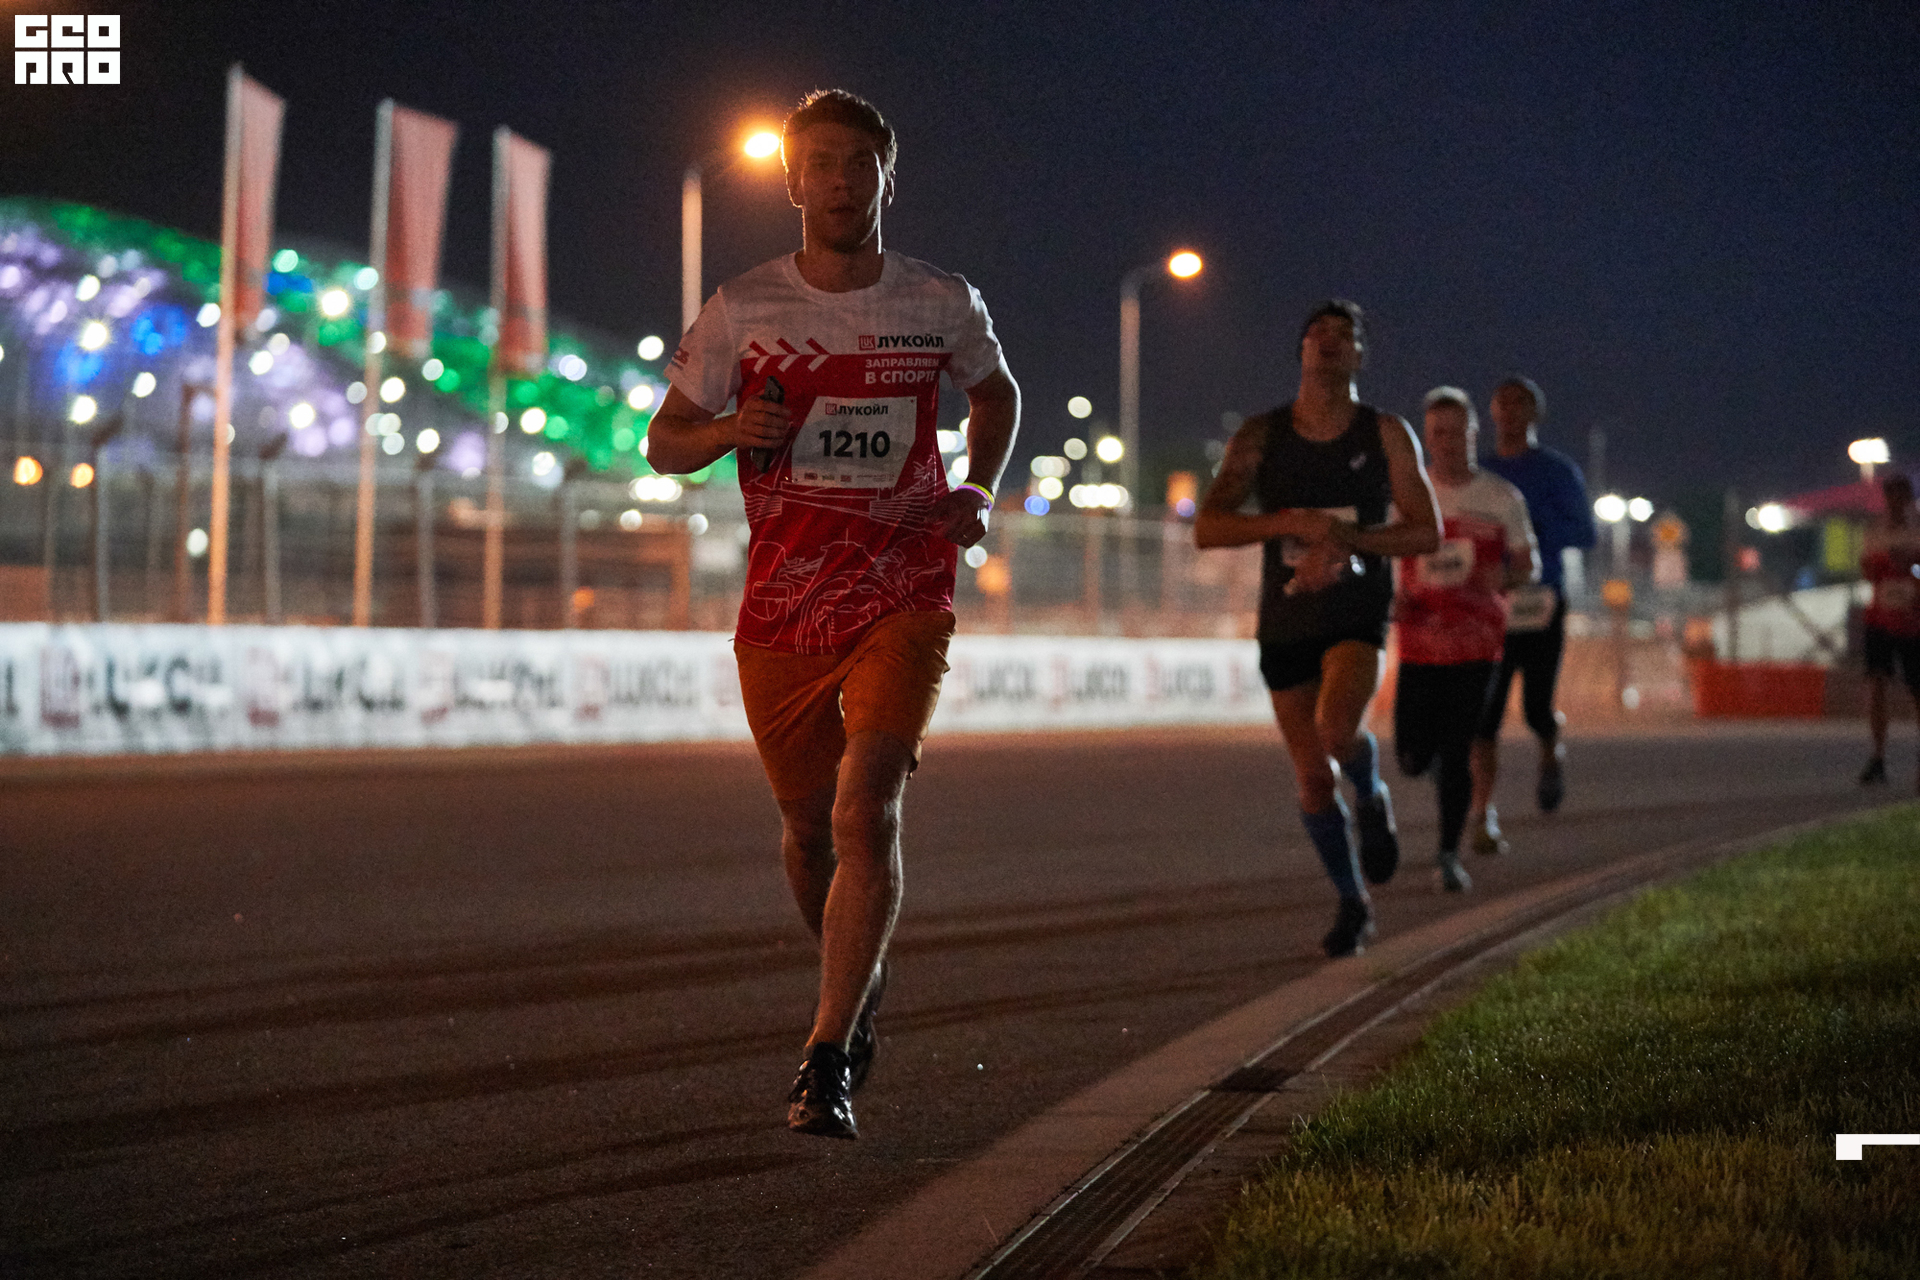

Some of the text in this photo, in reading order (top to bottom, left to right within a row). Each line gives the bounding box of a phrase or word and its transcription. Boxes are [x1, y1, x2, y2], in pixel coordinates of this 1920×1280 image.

[877, 333, 944, 348] ЛУКОЙЛ
[865, 358, 939, 369] ЗАПРАВЛЯЕМ
[865, 370, 936, 385] В СПОРТЕ
[838, 404, 889, 416] ЛУКОЙЛ
[819, 429, 891, 458] 1210
